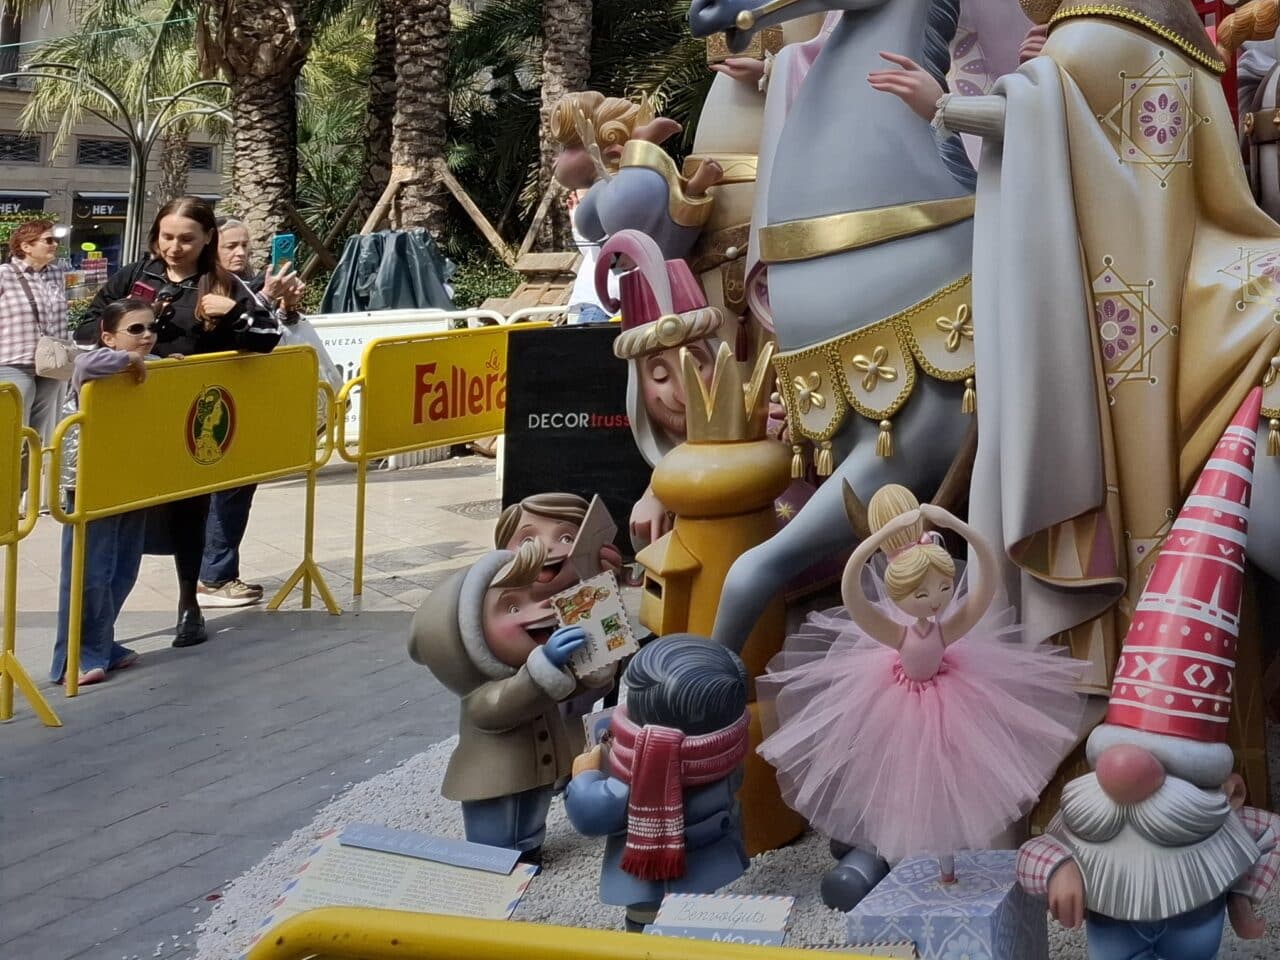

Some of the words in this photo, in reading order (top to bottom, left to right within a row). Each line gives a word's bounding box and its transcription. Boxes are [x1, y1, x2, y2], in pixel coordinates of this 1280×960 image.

[0, 203, 20, 214] HEY
[92, 205, 114, 215] HEY
[325, 338, 363, 346] RVEZAS
